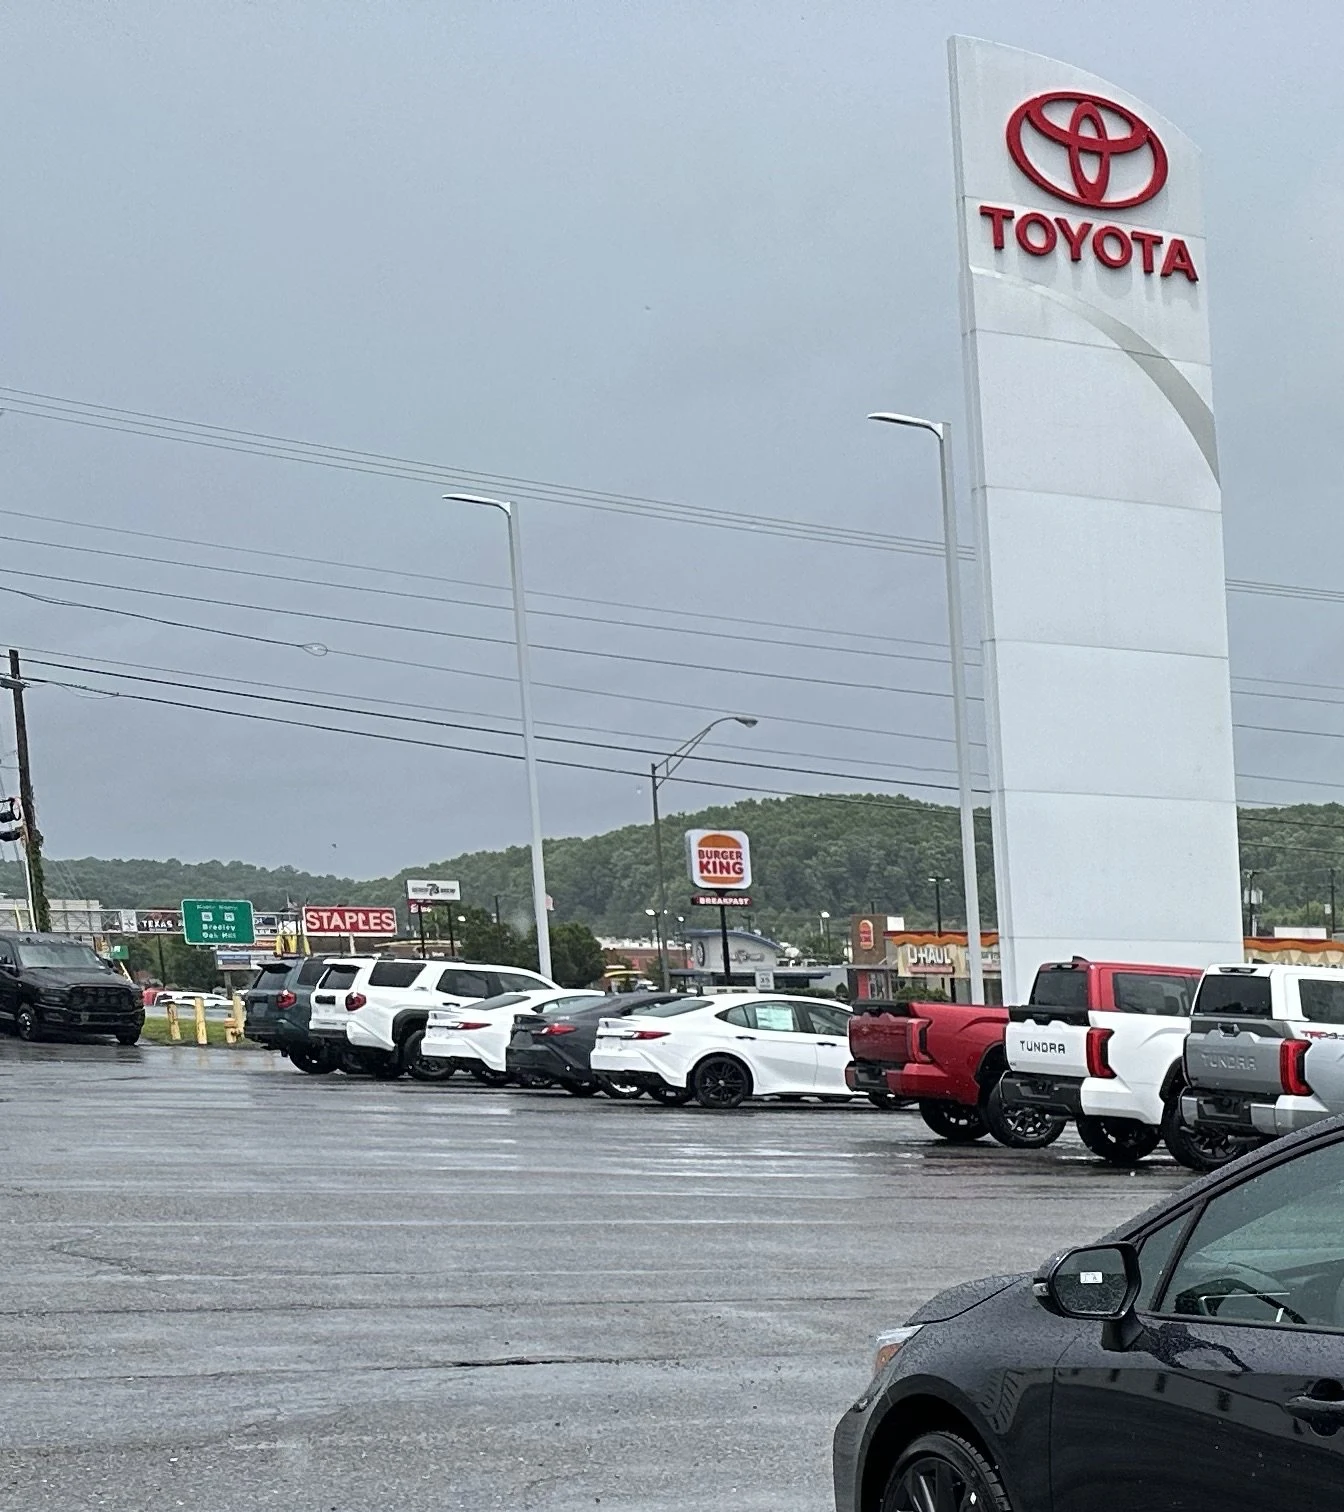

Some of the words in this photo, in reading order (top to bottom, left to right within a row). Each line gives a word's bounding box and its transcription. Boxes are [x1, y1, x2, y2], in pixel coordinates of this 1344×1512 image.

[980, 205, 1199, 282] TOYOTA
[698, 849, 743, 861] BURGER
[699, 860, 744, 875] KING
[699, 896, 750, 905] BREAKFAST
[141, 919, 173, 928] TEXAS
[306, 911, 395, 931] STAPLES
[1020, 1040, 1066, 1055] TUNDRA
[1200, 1052, 1257, 1071] TUNDRA
